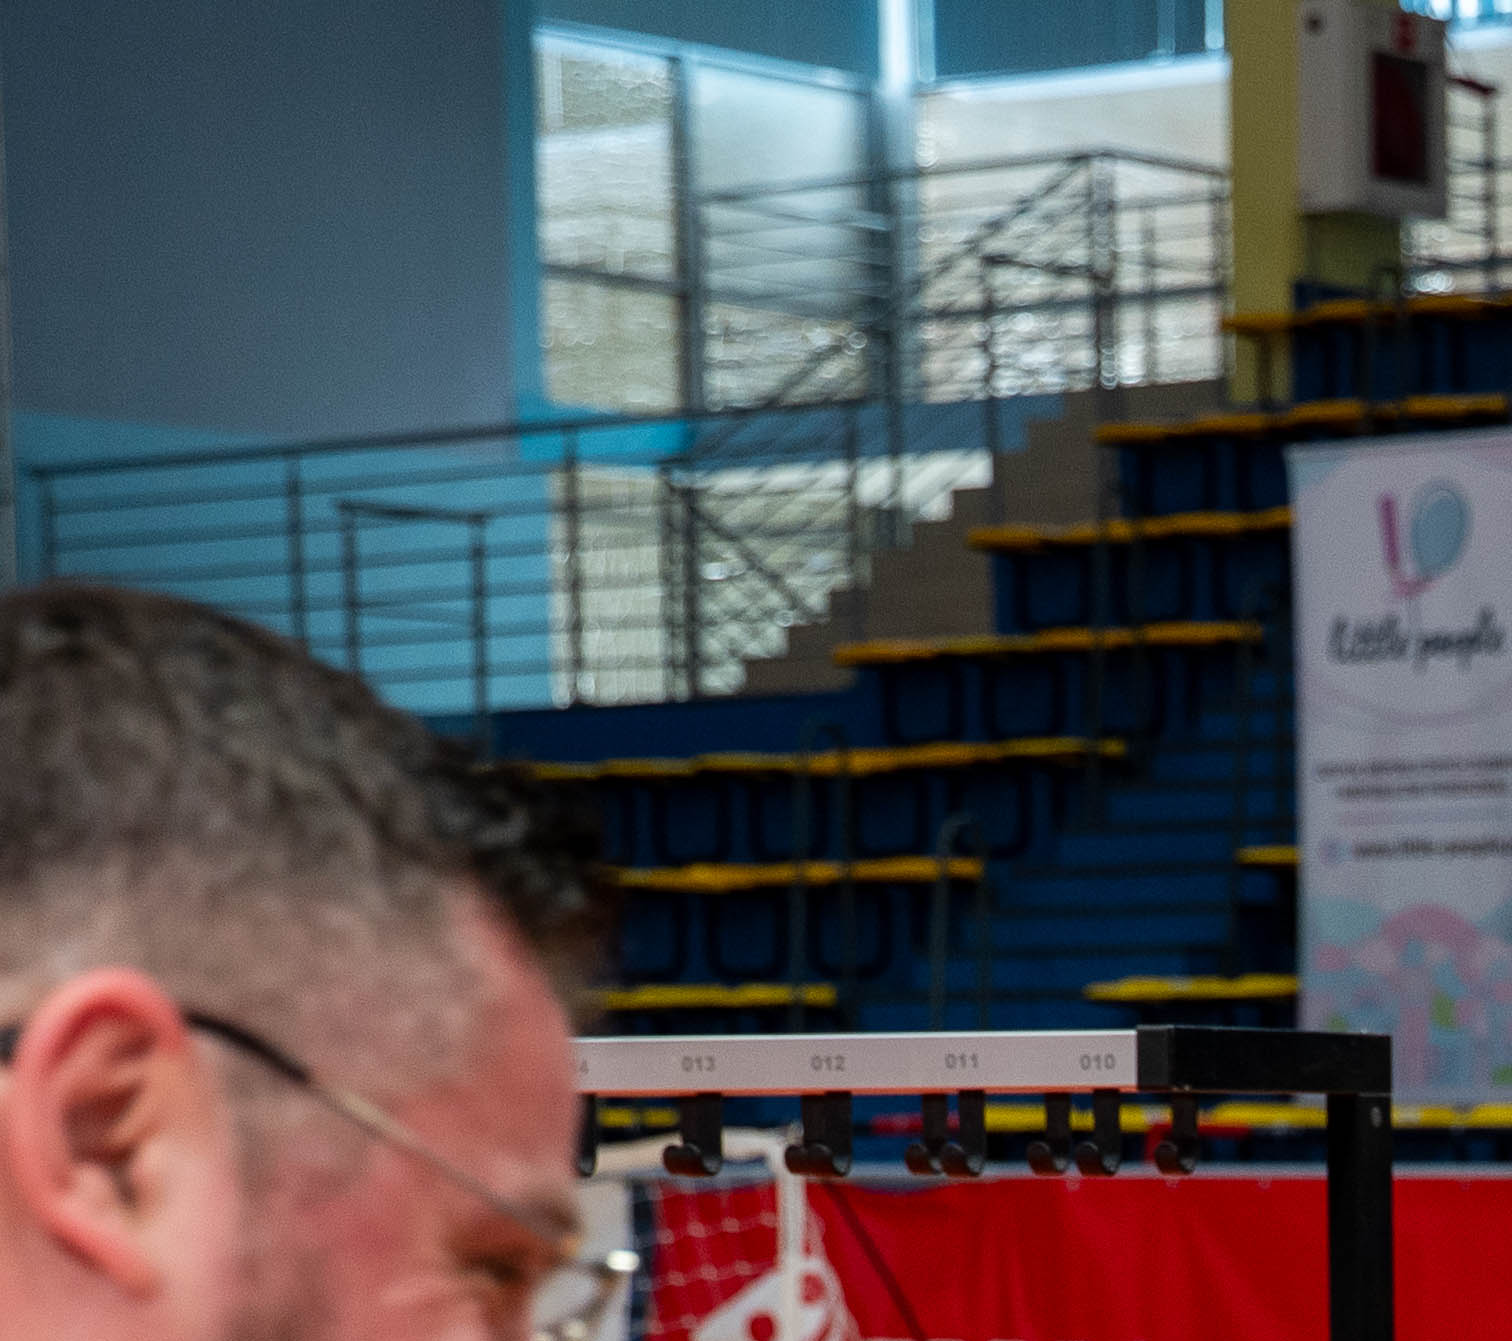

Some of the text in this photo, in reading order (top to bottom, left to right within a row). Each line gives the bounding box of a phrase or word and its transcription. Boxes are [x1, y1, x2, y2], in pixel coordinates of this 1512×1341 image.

[682, 1054, 715, 1073] 013
[811, 1054, 845, 1073] 012
[945, 1052, 979, 1071] 011
[1080, 1053, 1116, 1071] 010
